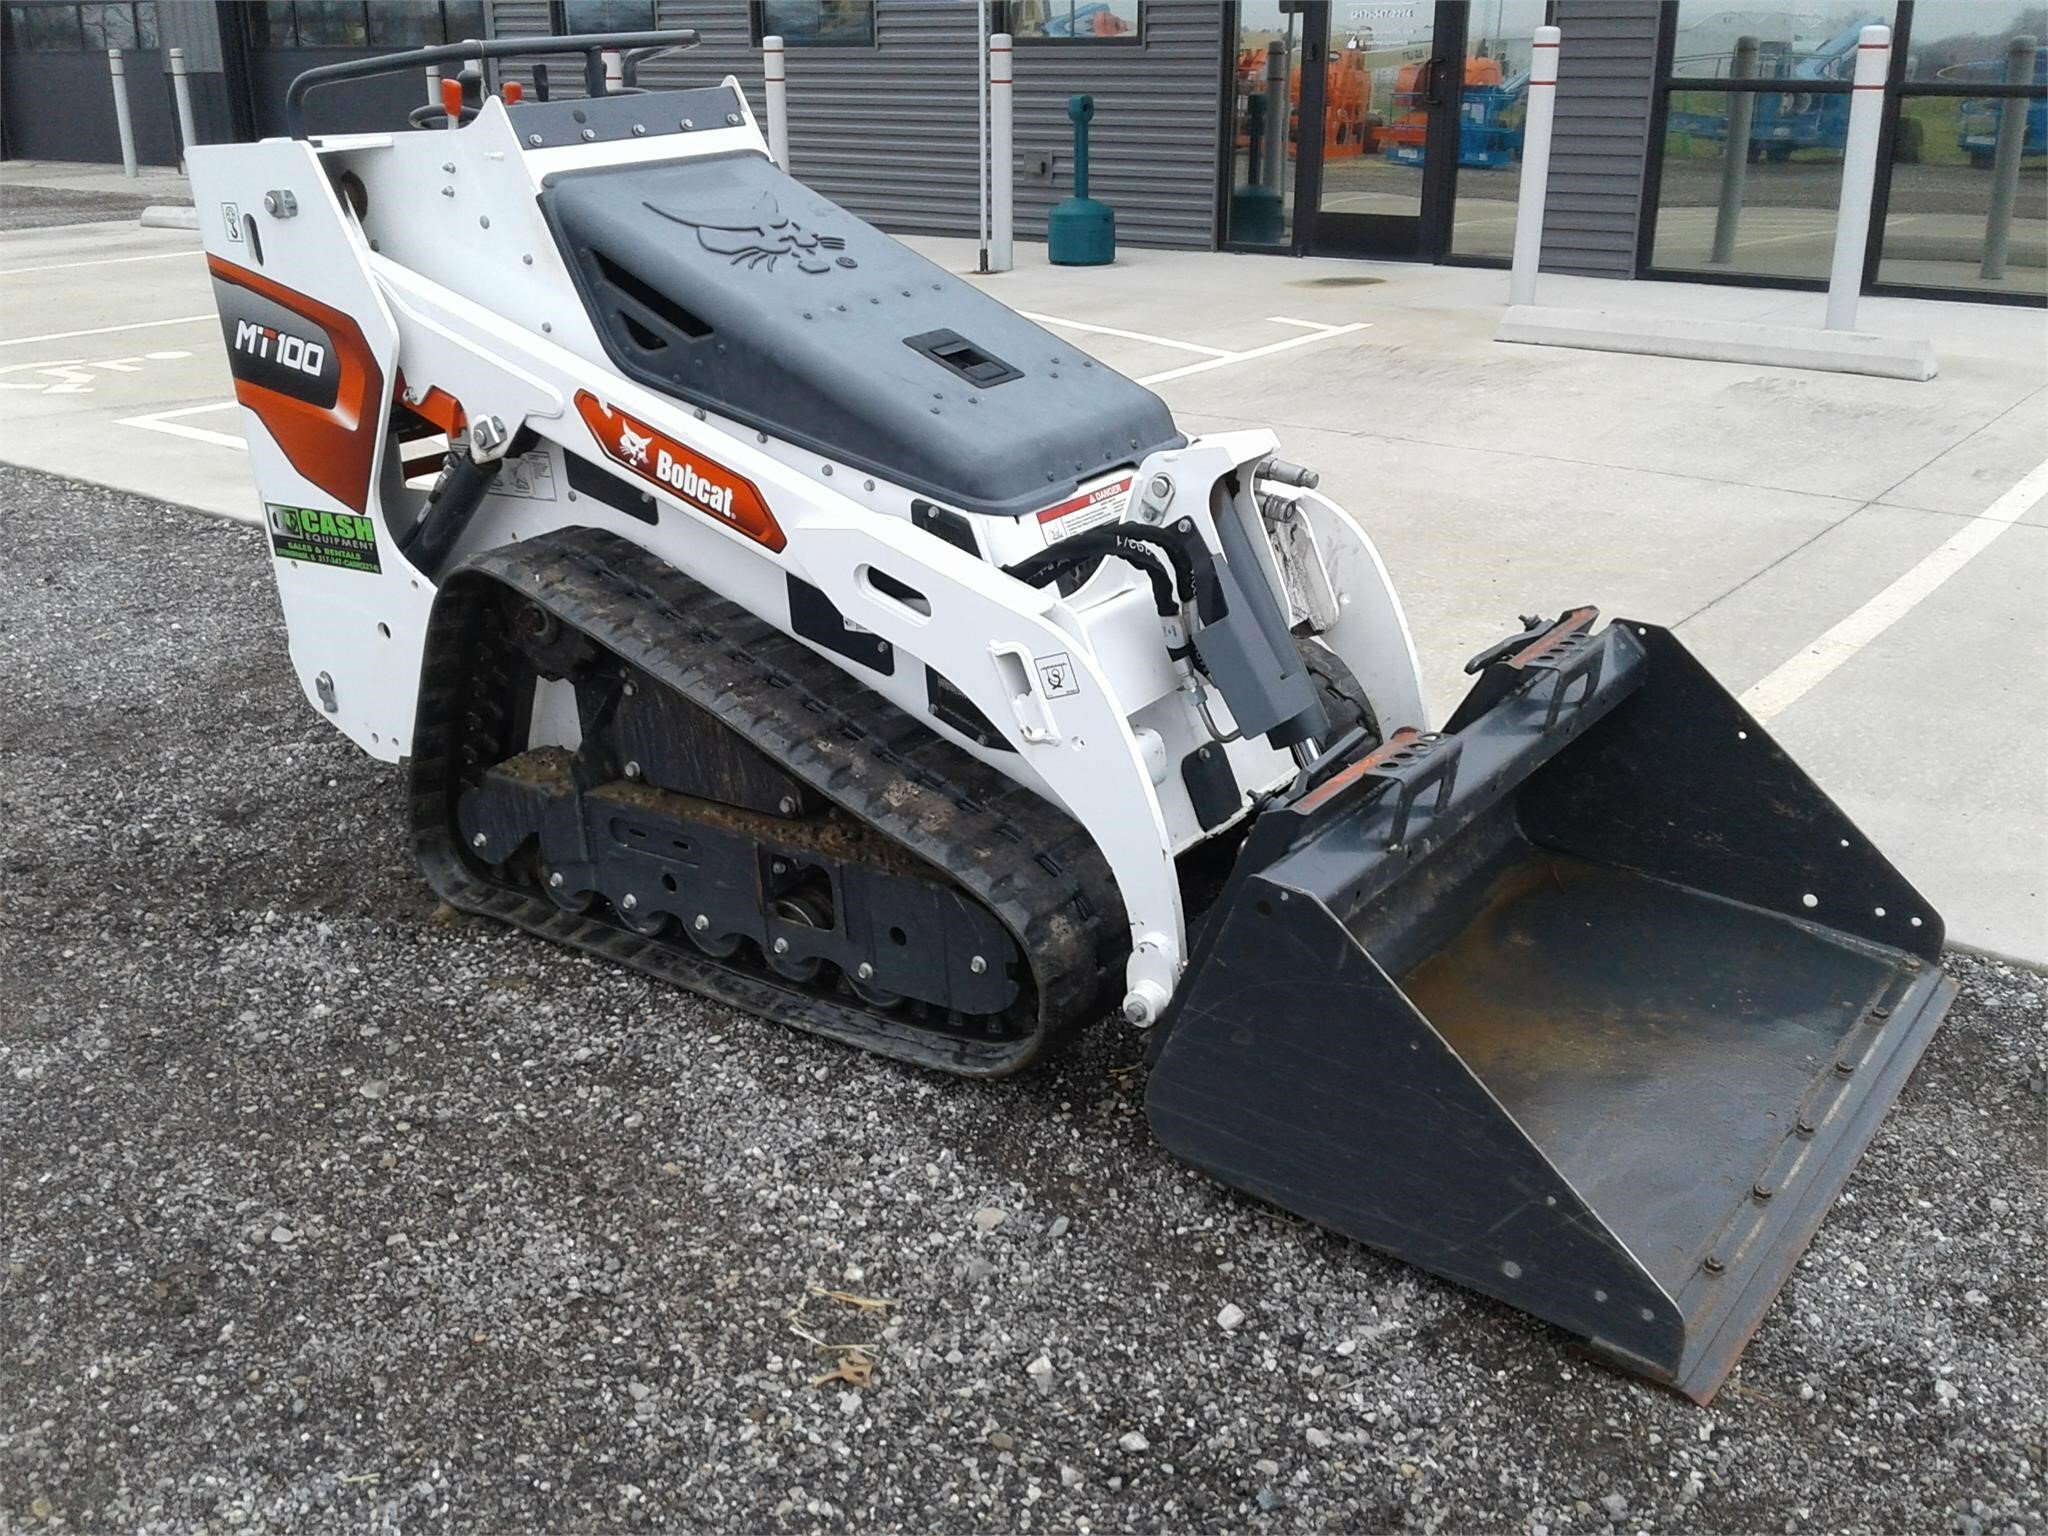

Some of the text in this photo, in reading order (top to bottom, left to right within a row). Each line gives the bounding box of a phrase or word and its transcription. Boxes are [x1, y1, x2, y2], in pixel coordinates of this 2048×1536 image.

[655, 449, 735, 519] Bobcat
[1095, 483, 1121, 501] DANGER
[300, 508, 375, 542] CASH
[287, 541, 313, 553] SALES
[314, 546, 322, 554] &
[323, 547, 362, 561] RENTALS
[304, 532, 375, 551] EQUIPMENT
